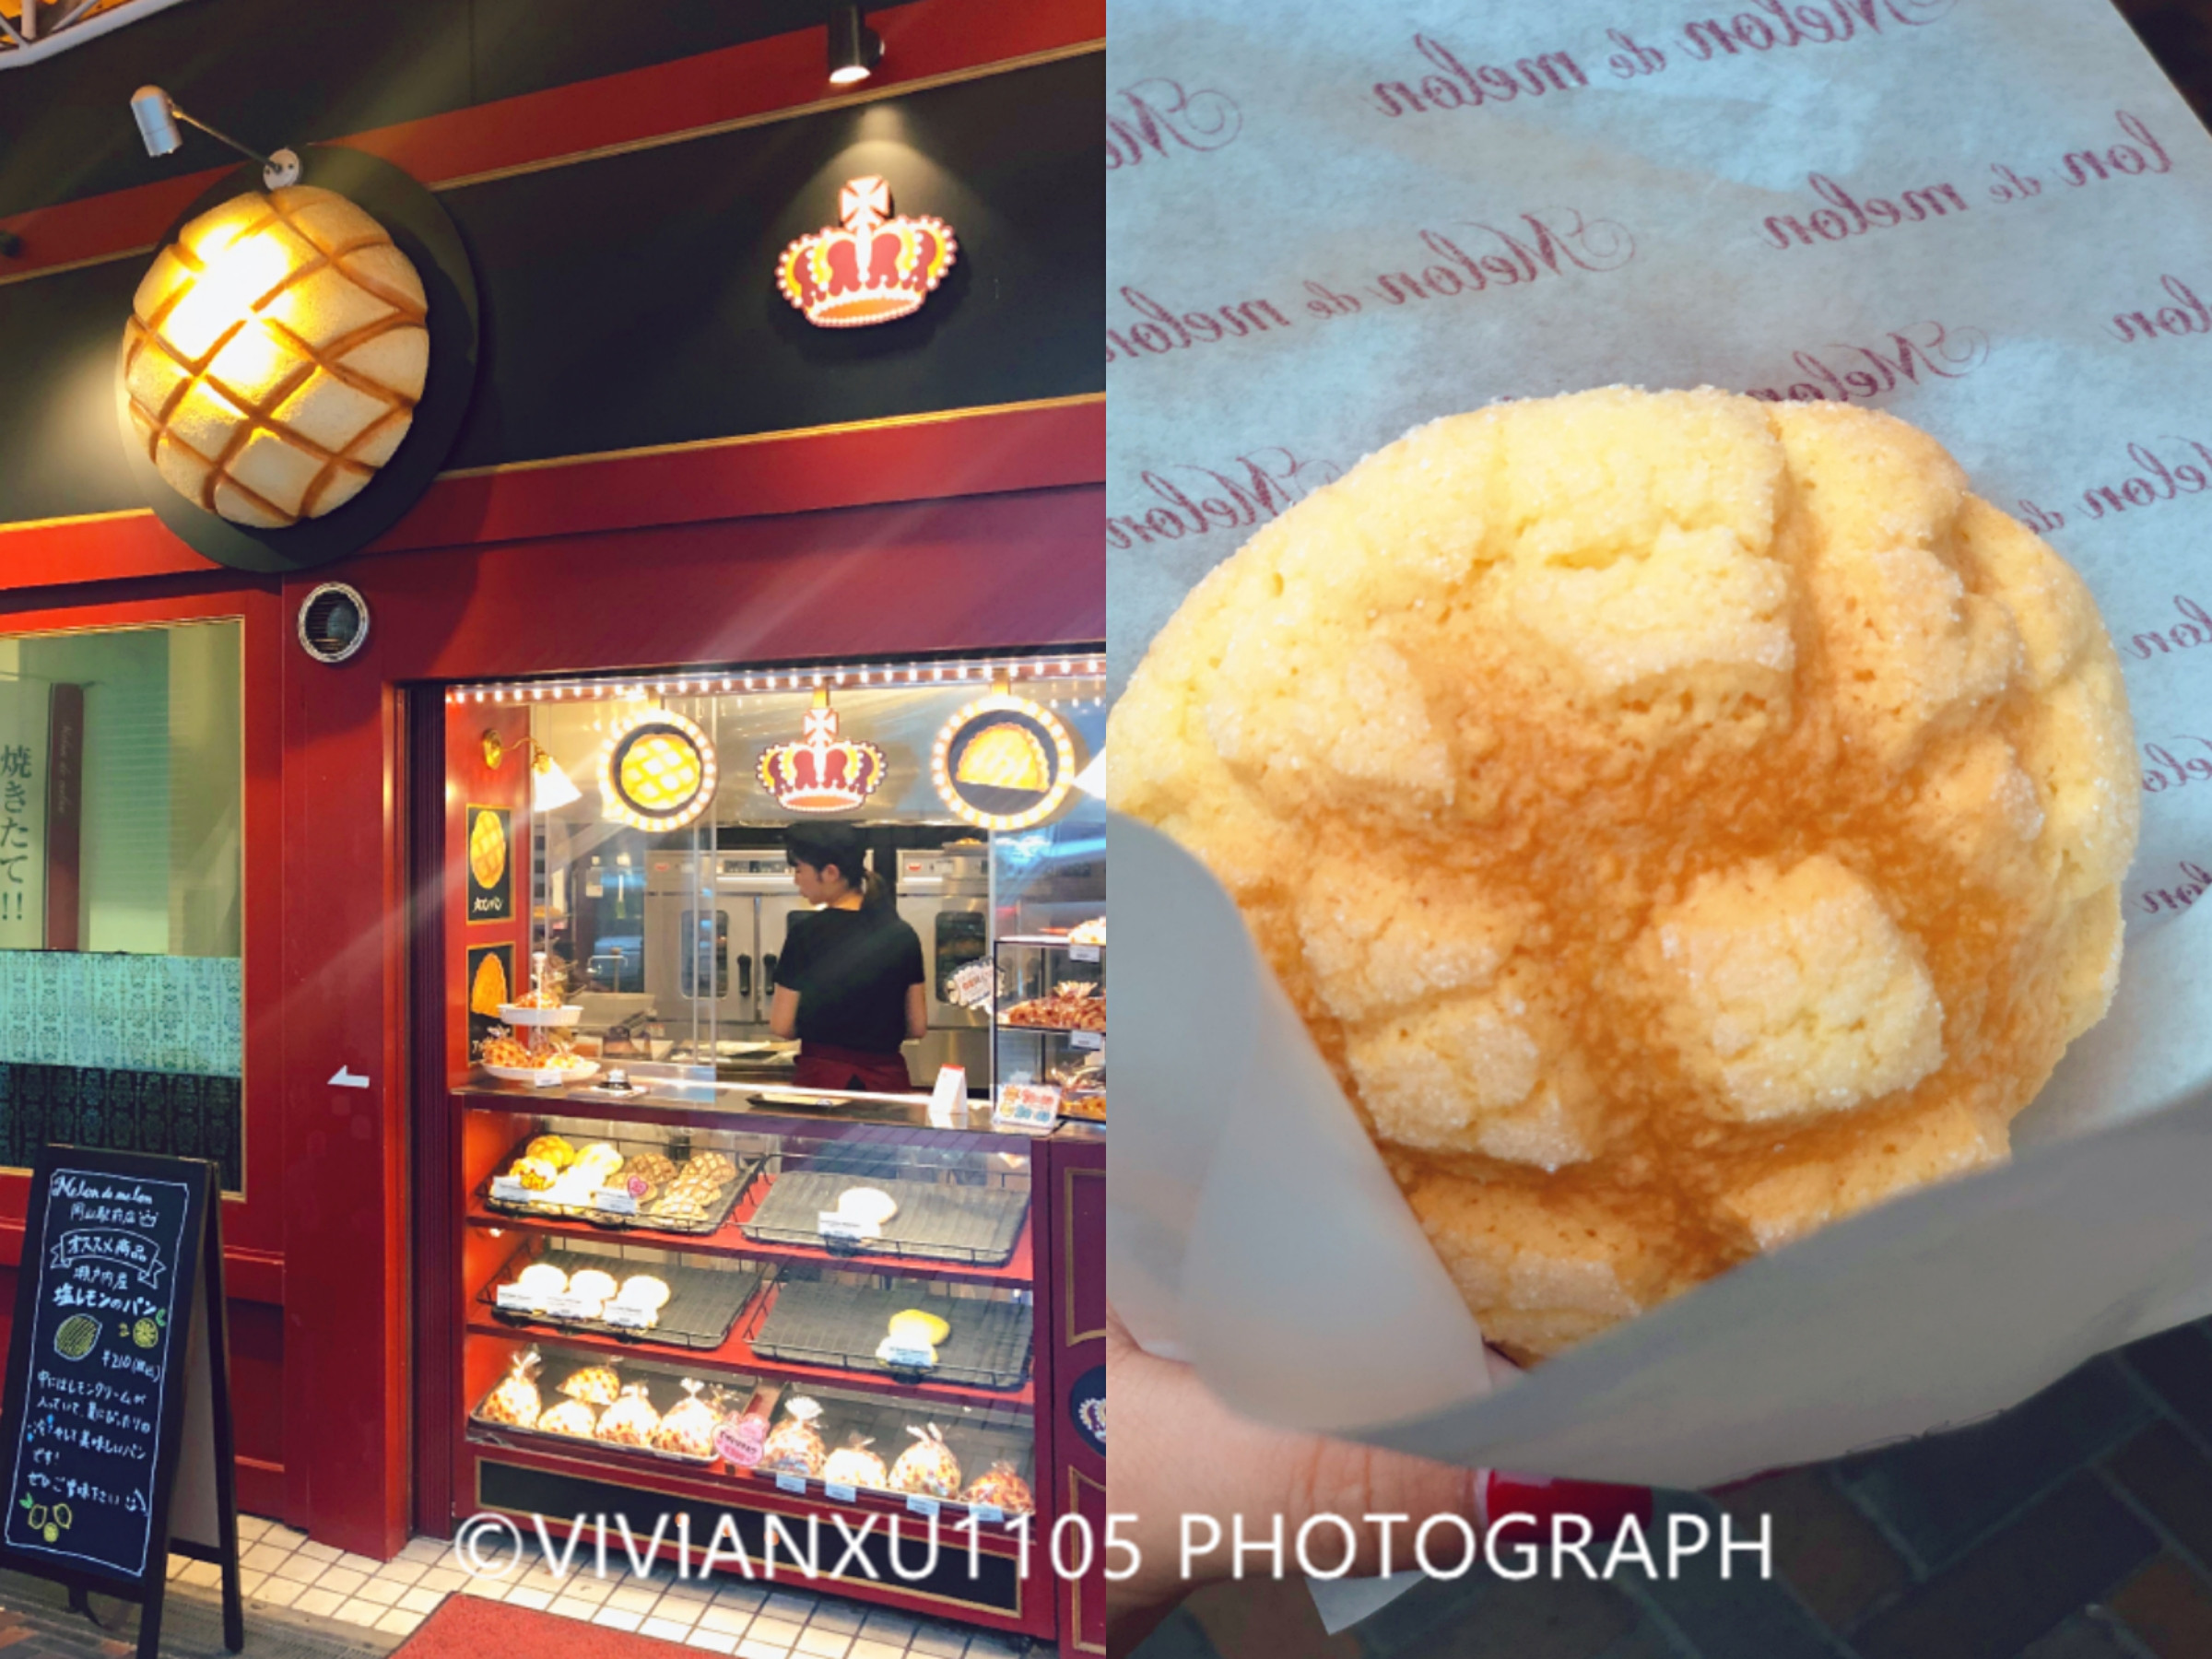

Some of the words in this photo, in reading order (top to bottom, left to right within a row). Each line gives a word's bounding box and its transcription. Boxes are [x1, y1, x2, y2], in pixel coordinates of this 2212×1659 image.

[67, 1235, 147, 1263] オススメ商品
[53, 1282, 157, 1316] 塩レモンのパン
